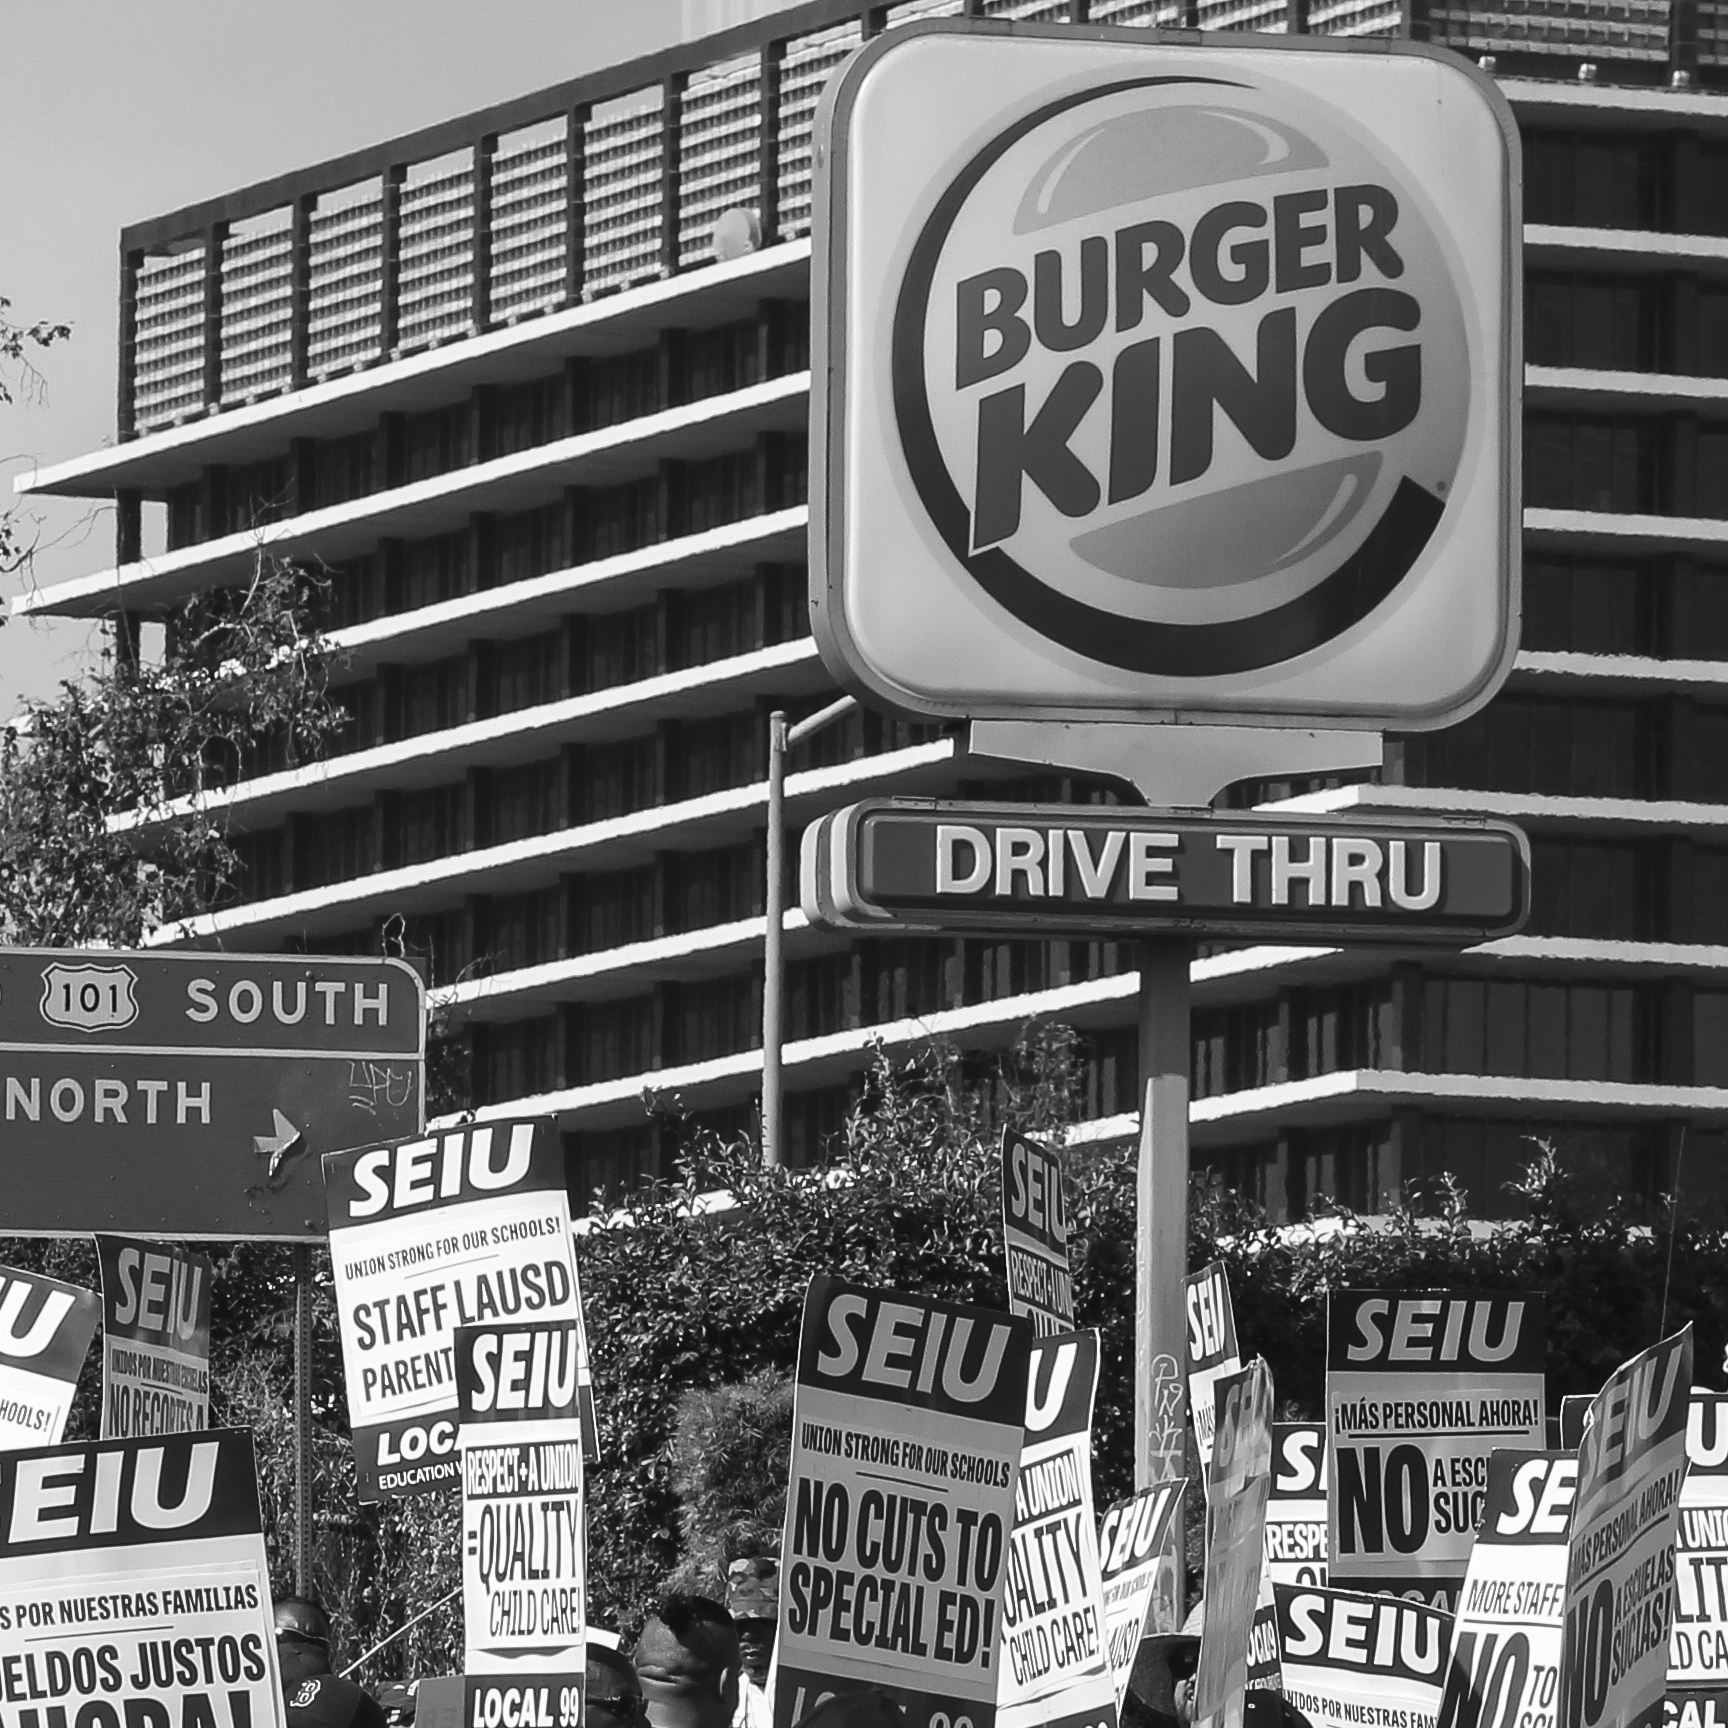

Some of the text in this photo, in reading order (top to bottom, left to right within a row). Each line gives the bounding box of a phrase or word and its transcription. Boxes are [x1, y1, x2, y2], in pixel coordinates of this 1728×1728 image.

[956, 184, 1406, 392] BURGER
[972, 287, 1423, 553] KING
[935, 825, 1442, 910] DRIVE THRU
[62, 983, 120, 1014] 101
[185, 979, 389, 1026] SOUTH
[5, 1077, 212, 1125] NORTH
[349, 1124, 535, 1217] SEIU
[345, 1216, 561, 1280] UNION STRONG FOR OUR SCHOOLS!
[116, 1248, 202, 1340] SEIU
[353, 1260, 571, 1351] STAFF LAUSD
[1187, 1273, 1225, 1362] SEIU
[1347, 1299, 1525, 1363] SEIU
[471, 1330, 578, 1412] SEIU
[817, 1292, 1011, 1402] SEIU
[801, 1421, 1010, 1490] UNION STRONG FOR OUR SCHOOLS
[1334, 1397, 1540, 1434] ¡MÁS PERSONAL AHORA!
[379, 1463, 454, 1490] EDUCATION
[1335, 1444, 1430, 1555] NO
[794, 1476, 1002, 1592] NO CUTS TO
[788, 1562, 993, 1669] SPECIAL ED!
[1285, 1594, 1441, 1675] SEIU
[473, 1687, 579, 1728] LOCAL 99
